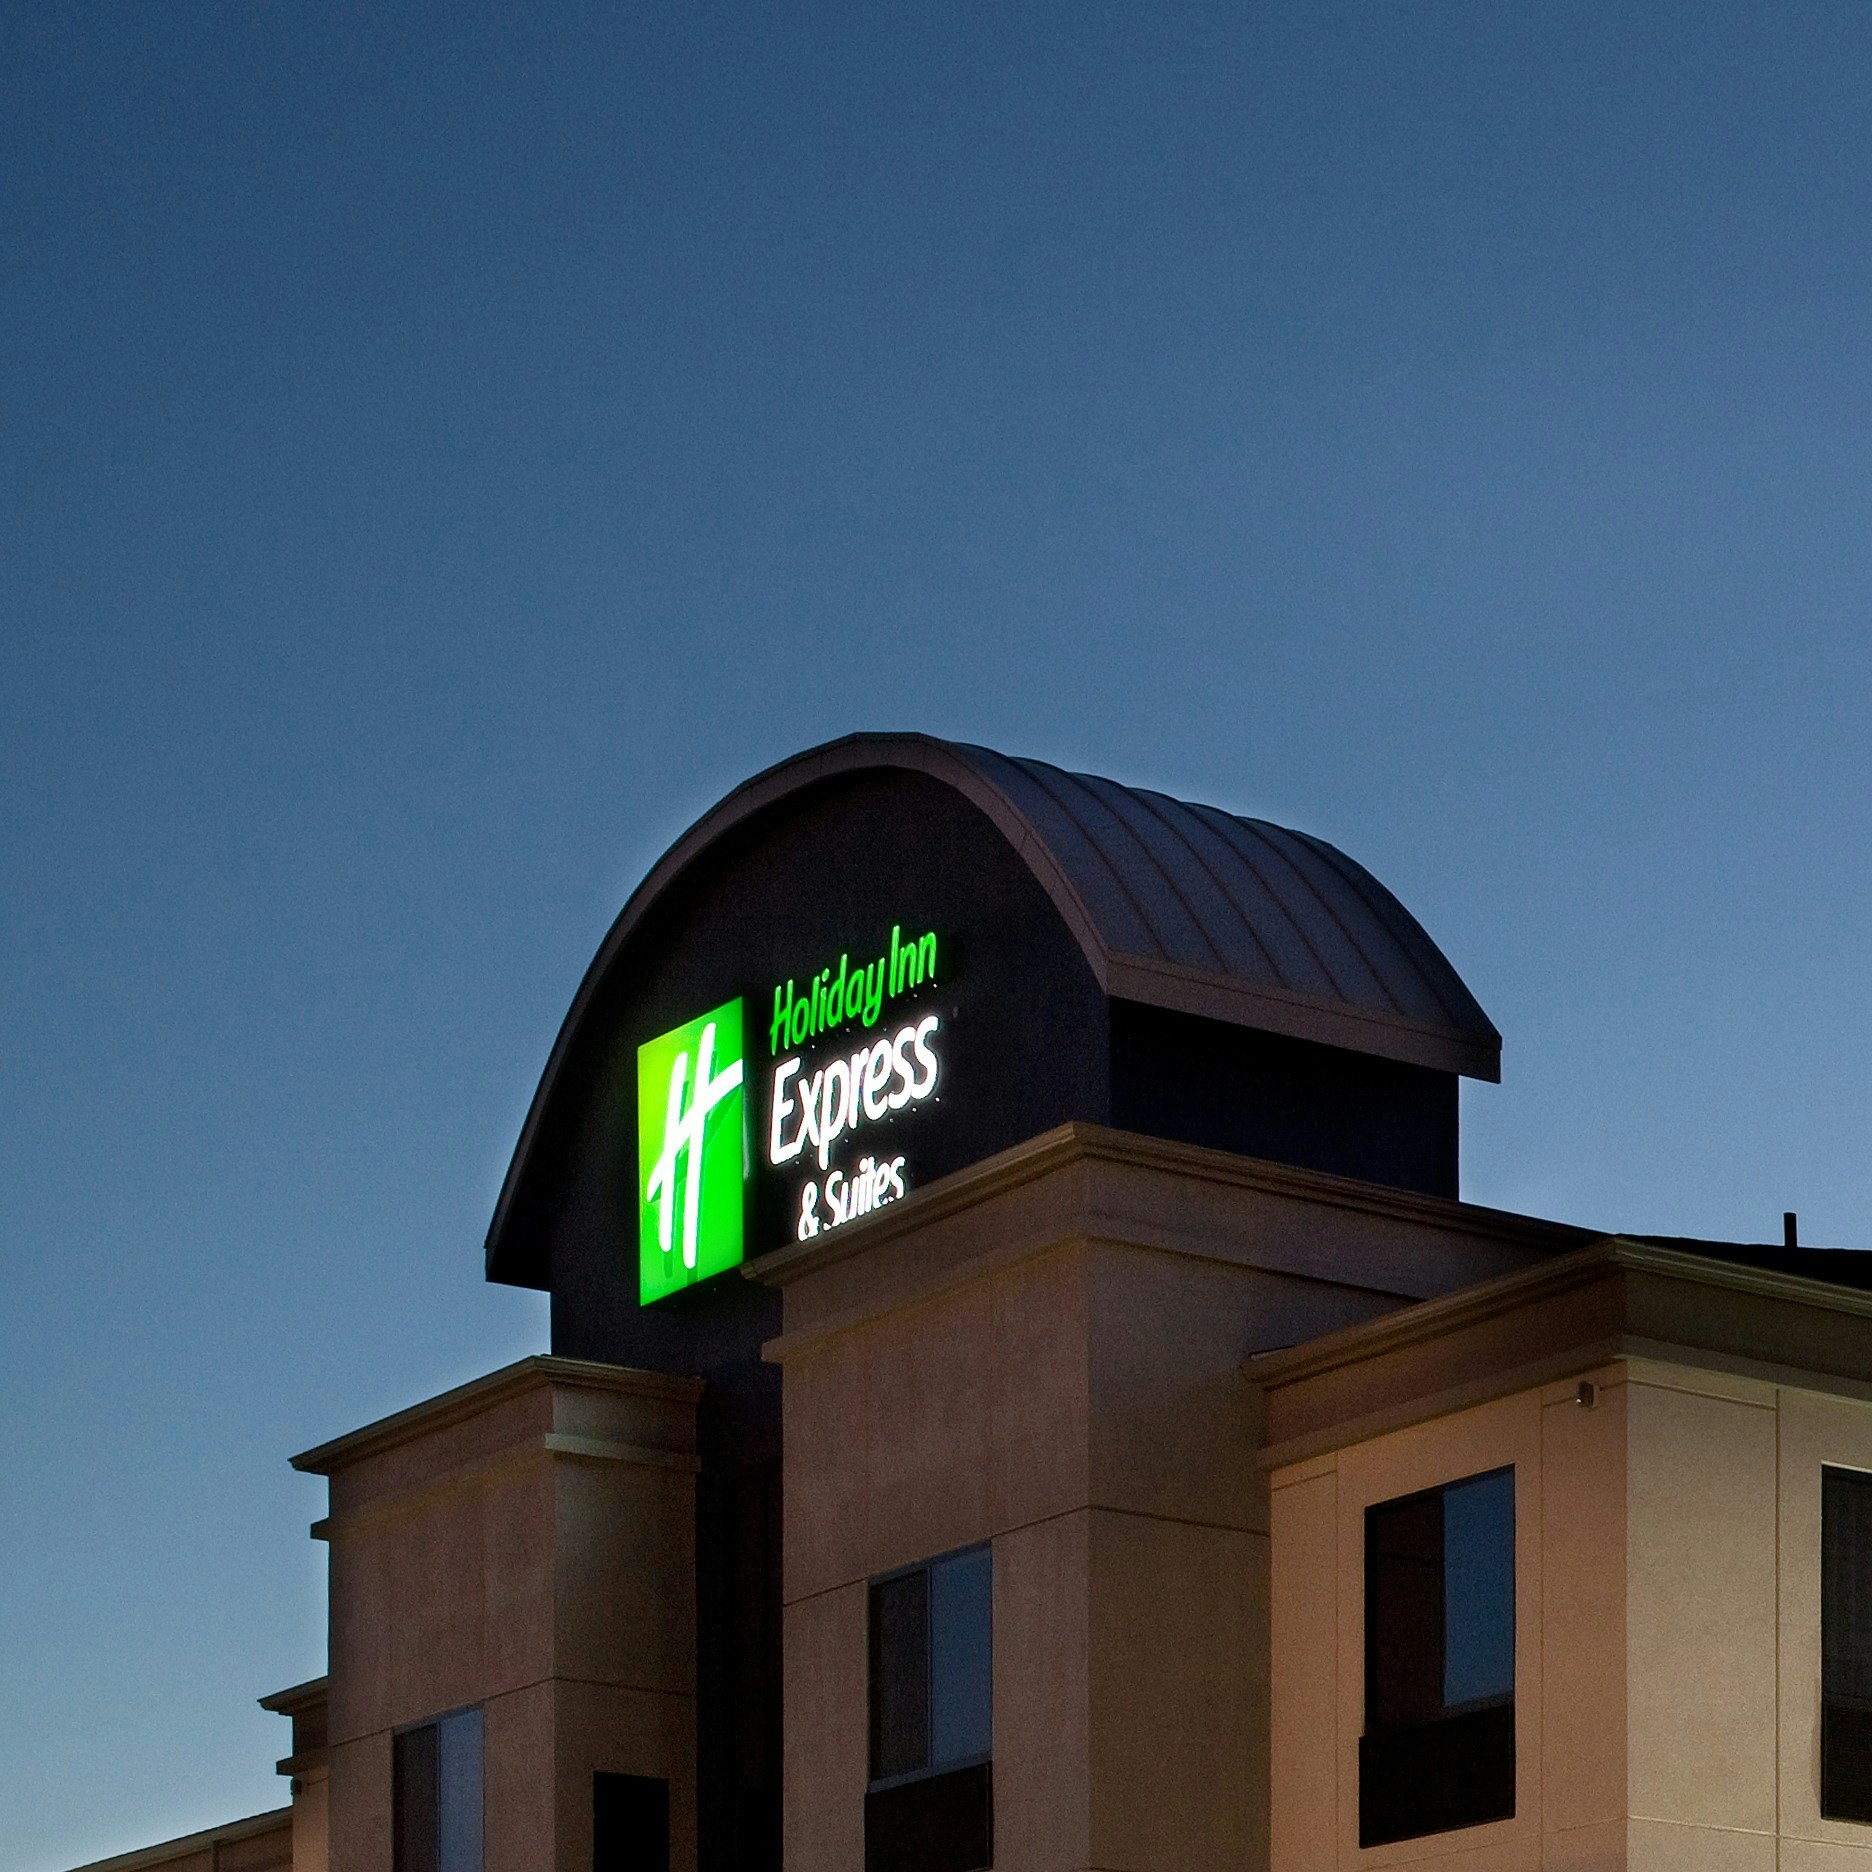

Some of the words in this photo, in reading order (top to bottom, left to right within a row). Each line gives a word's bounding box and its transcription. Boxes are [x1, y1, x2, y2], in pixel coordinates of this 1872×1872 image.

[769, 953, 885, 1055] Holiday
[889, 925, 937, 998] Inn
[769, 1015, 940, 1170] Express
[797, 1181, 820, 1241] &
[822, 1156, 906, 1231] Suites
